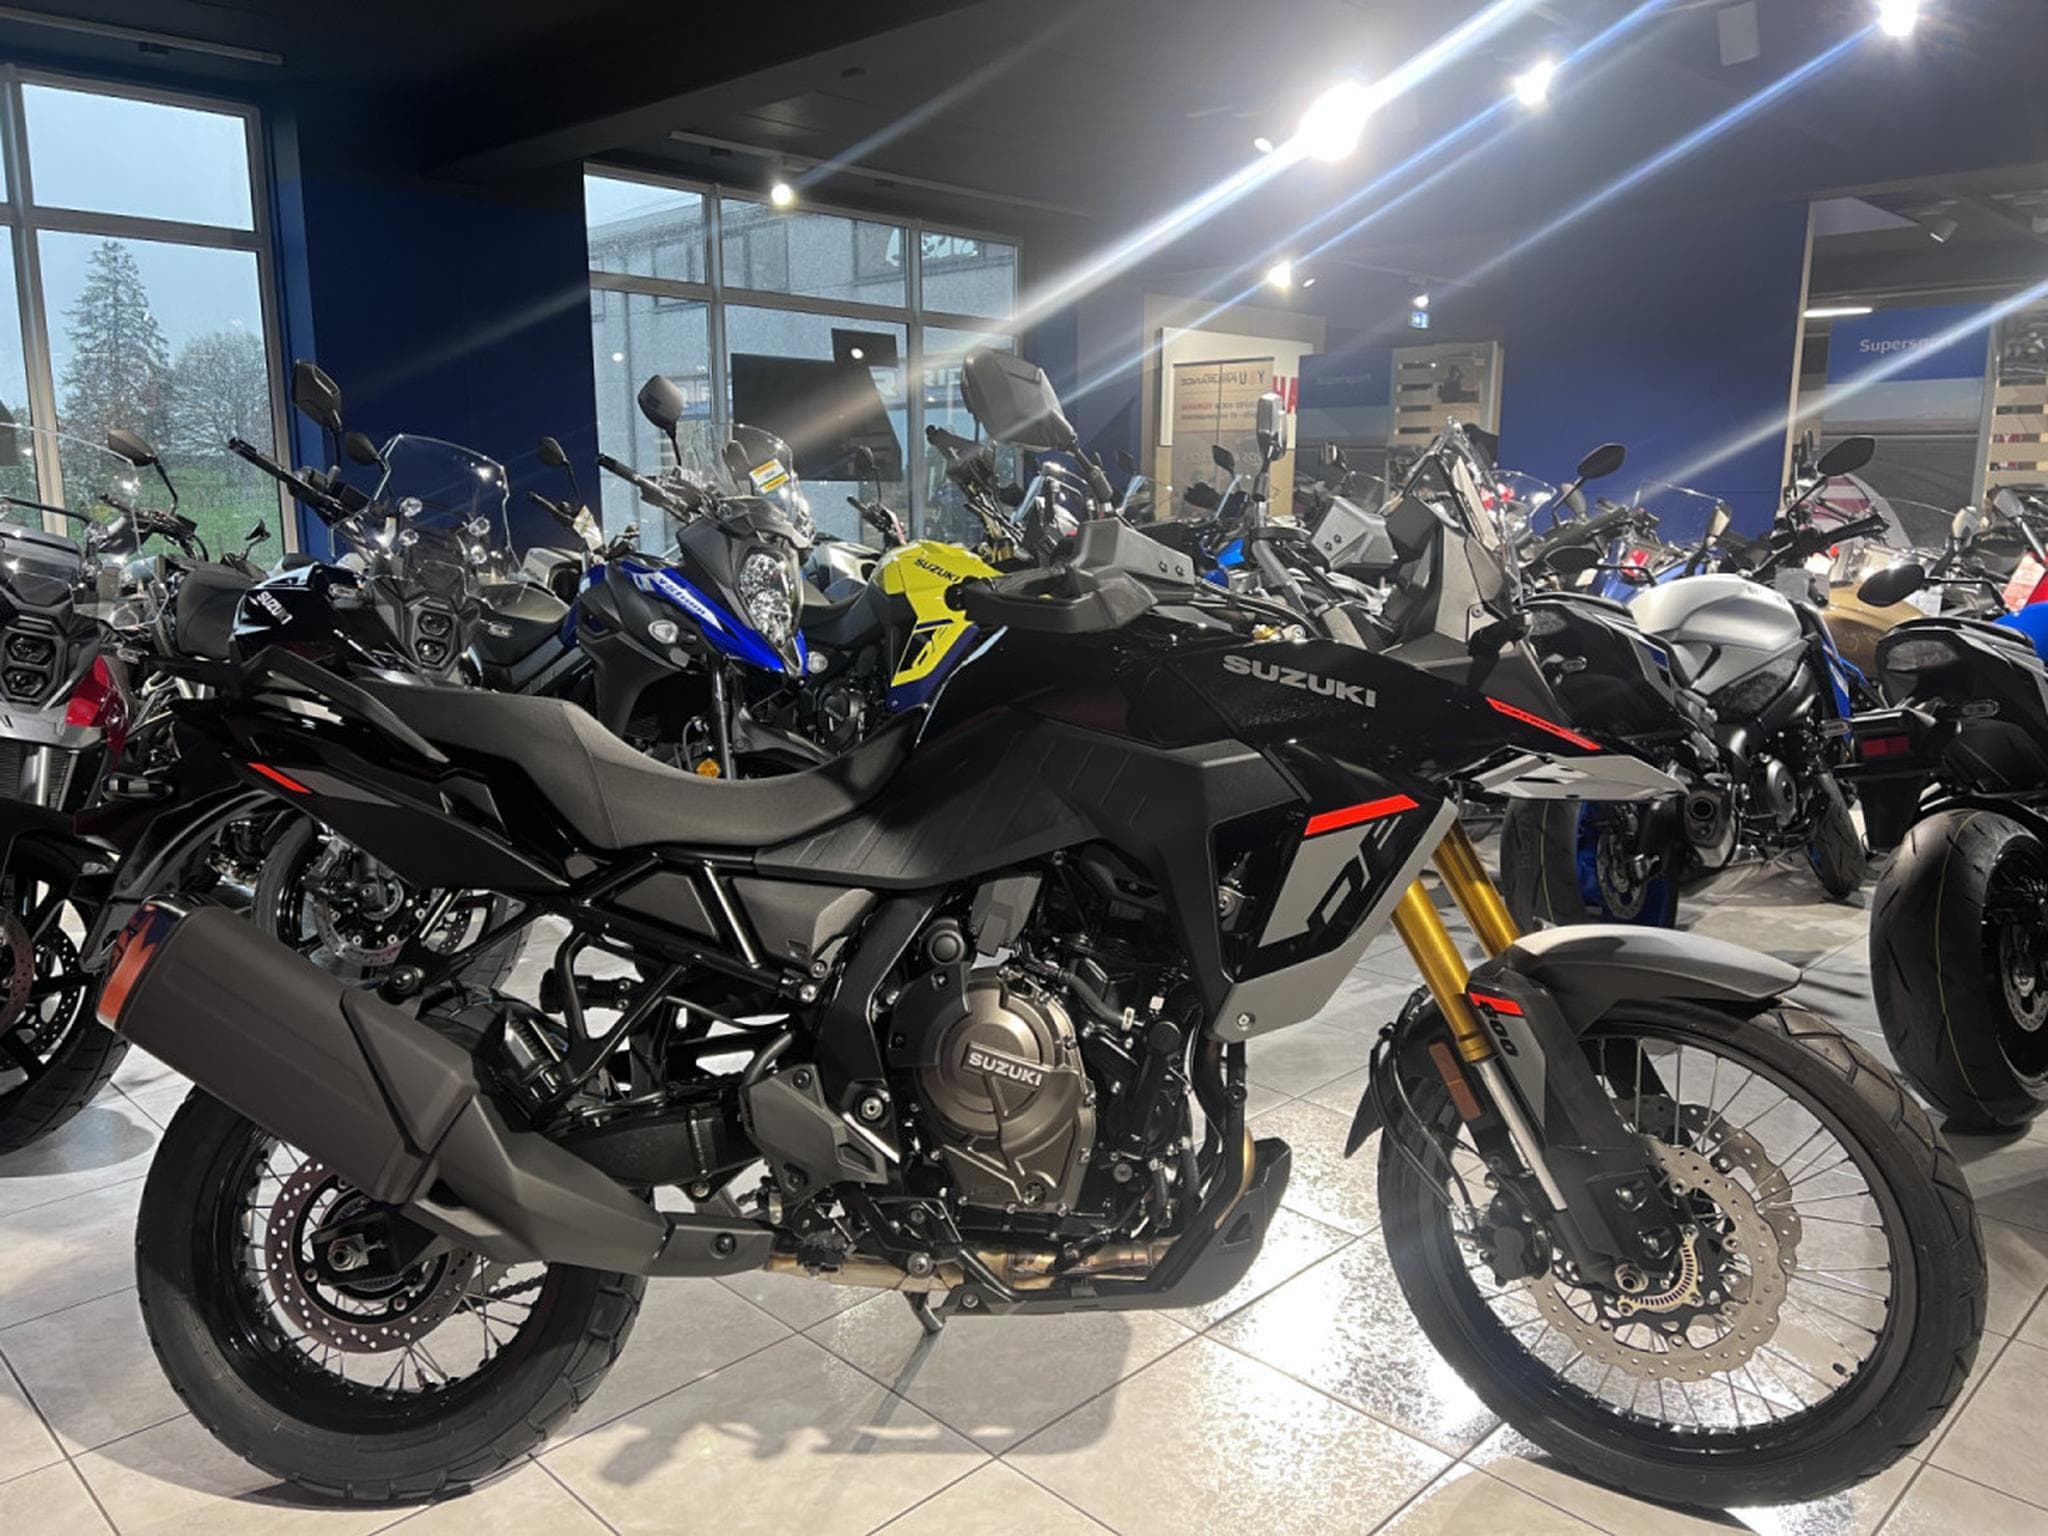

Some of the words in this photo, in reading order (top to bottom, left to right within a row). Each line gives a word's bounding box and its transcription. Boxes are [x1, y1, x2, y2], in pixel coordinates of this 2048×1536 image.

[914, 558, 961, 582] SUZUKI
[1223, 654, 1377, 708] SUZUKI
[968, 1051, 1043, 1087] SUZUKI
